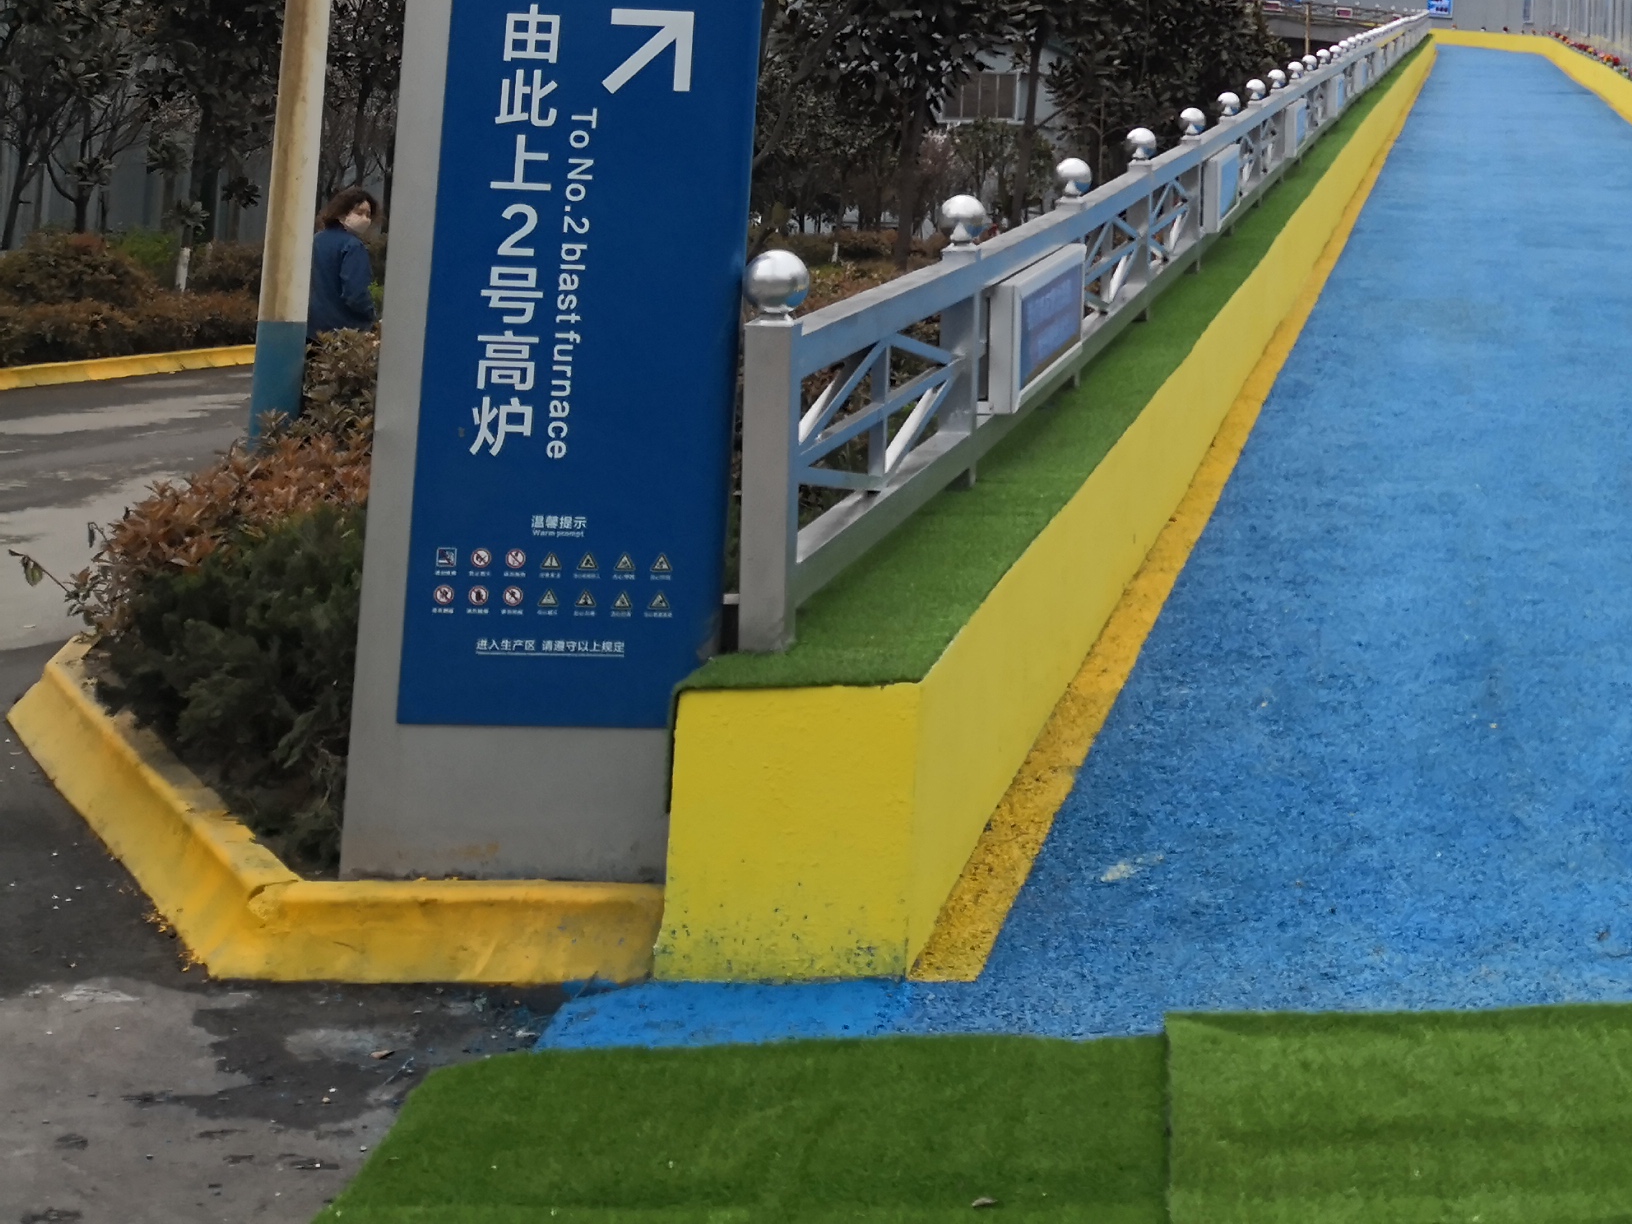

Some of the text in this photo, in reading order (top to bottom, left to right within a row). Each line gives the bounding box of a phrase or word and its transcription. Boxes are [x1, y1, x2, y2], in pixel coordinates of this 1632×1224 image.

[469, 4, 560, 456] 由此上2号高炉
[546, 108, 598, 459] To No.2 blast furnace
[531, 515, 587, 529] 温馨提示
[476, 639, 624, 653] 进入生产区 请遵守以上规定
